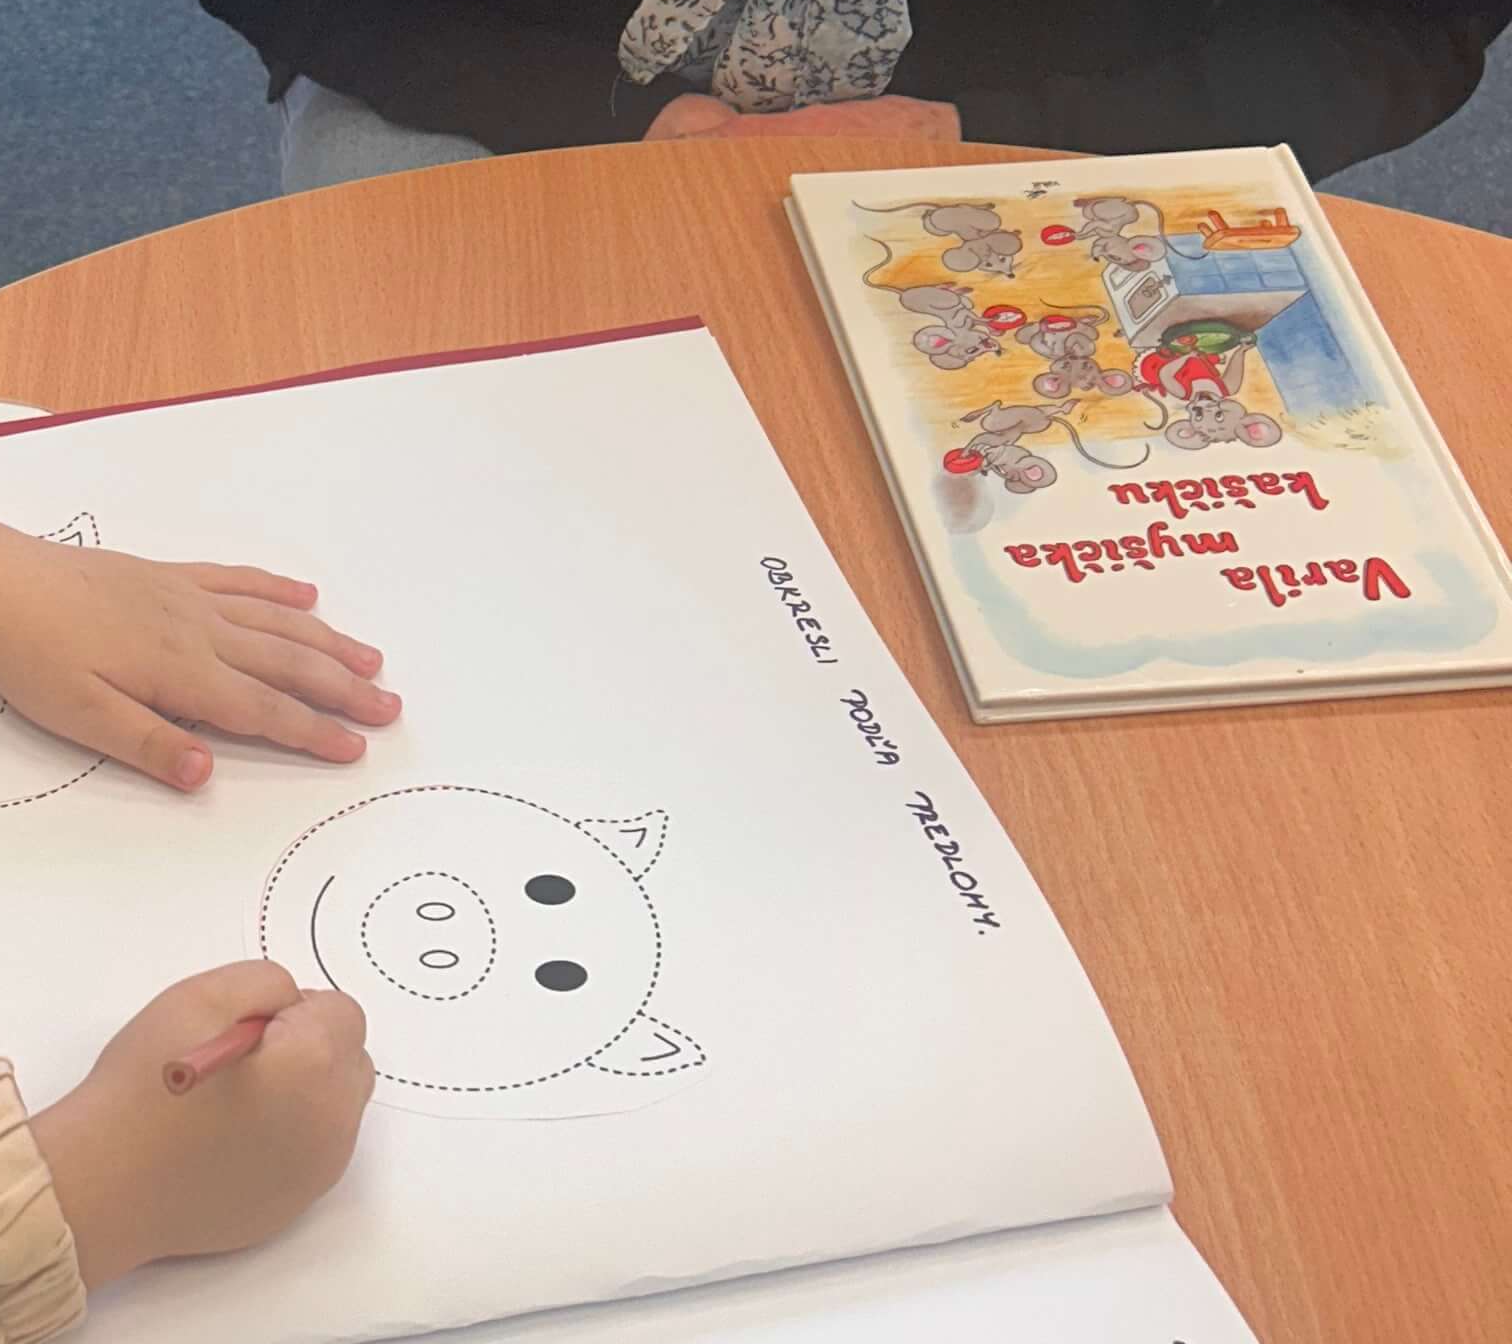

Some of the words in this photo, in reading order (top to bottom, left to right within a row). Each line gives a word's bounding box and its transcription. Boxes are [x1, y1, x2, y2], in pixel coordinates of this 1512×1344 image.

[1107, 470, 1330, 512] kašičku
[1003, 520, 1240, 584] myšička
[759, 556, 839, 664] OBKRESLI
[1219, 555, 1412, 608] Varila
